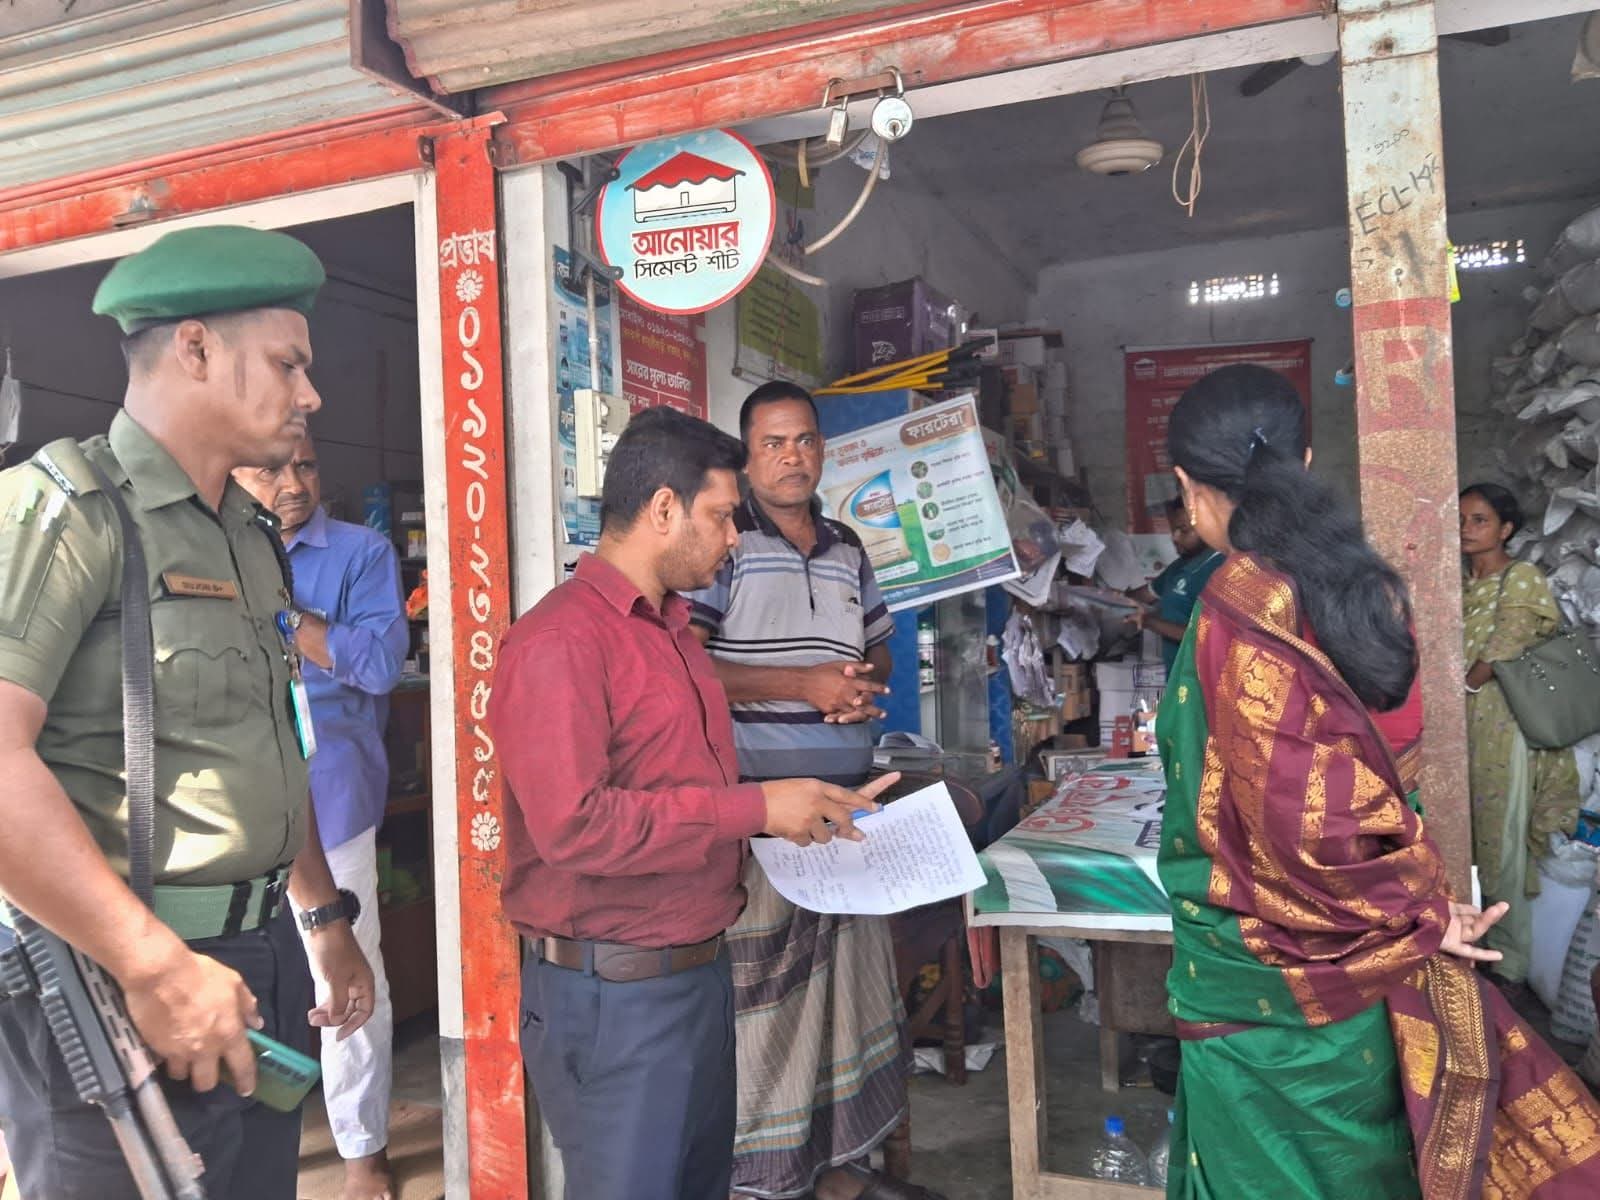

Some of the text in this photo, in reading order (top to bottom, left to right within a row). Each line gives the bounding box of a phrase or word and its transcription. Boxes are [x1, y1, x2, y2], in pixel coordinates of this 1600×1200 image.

[631, 221, 740, 256] আনোয়ার
[634, 249, 741, 279] সিমেন্ট শীট
